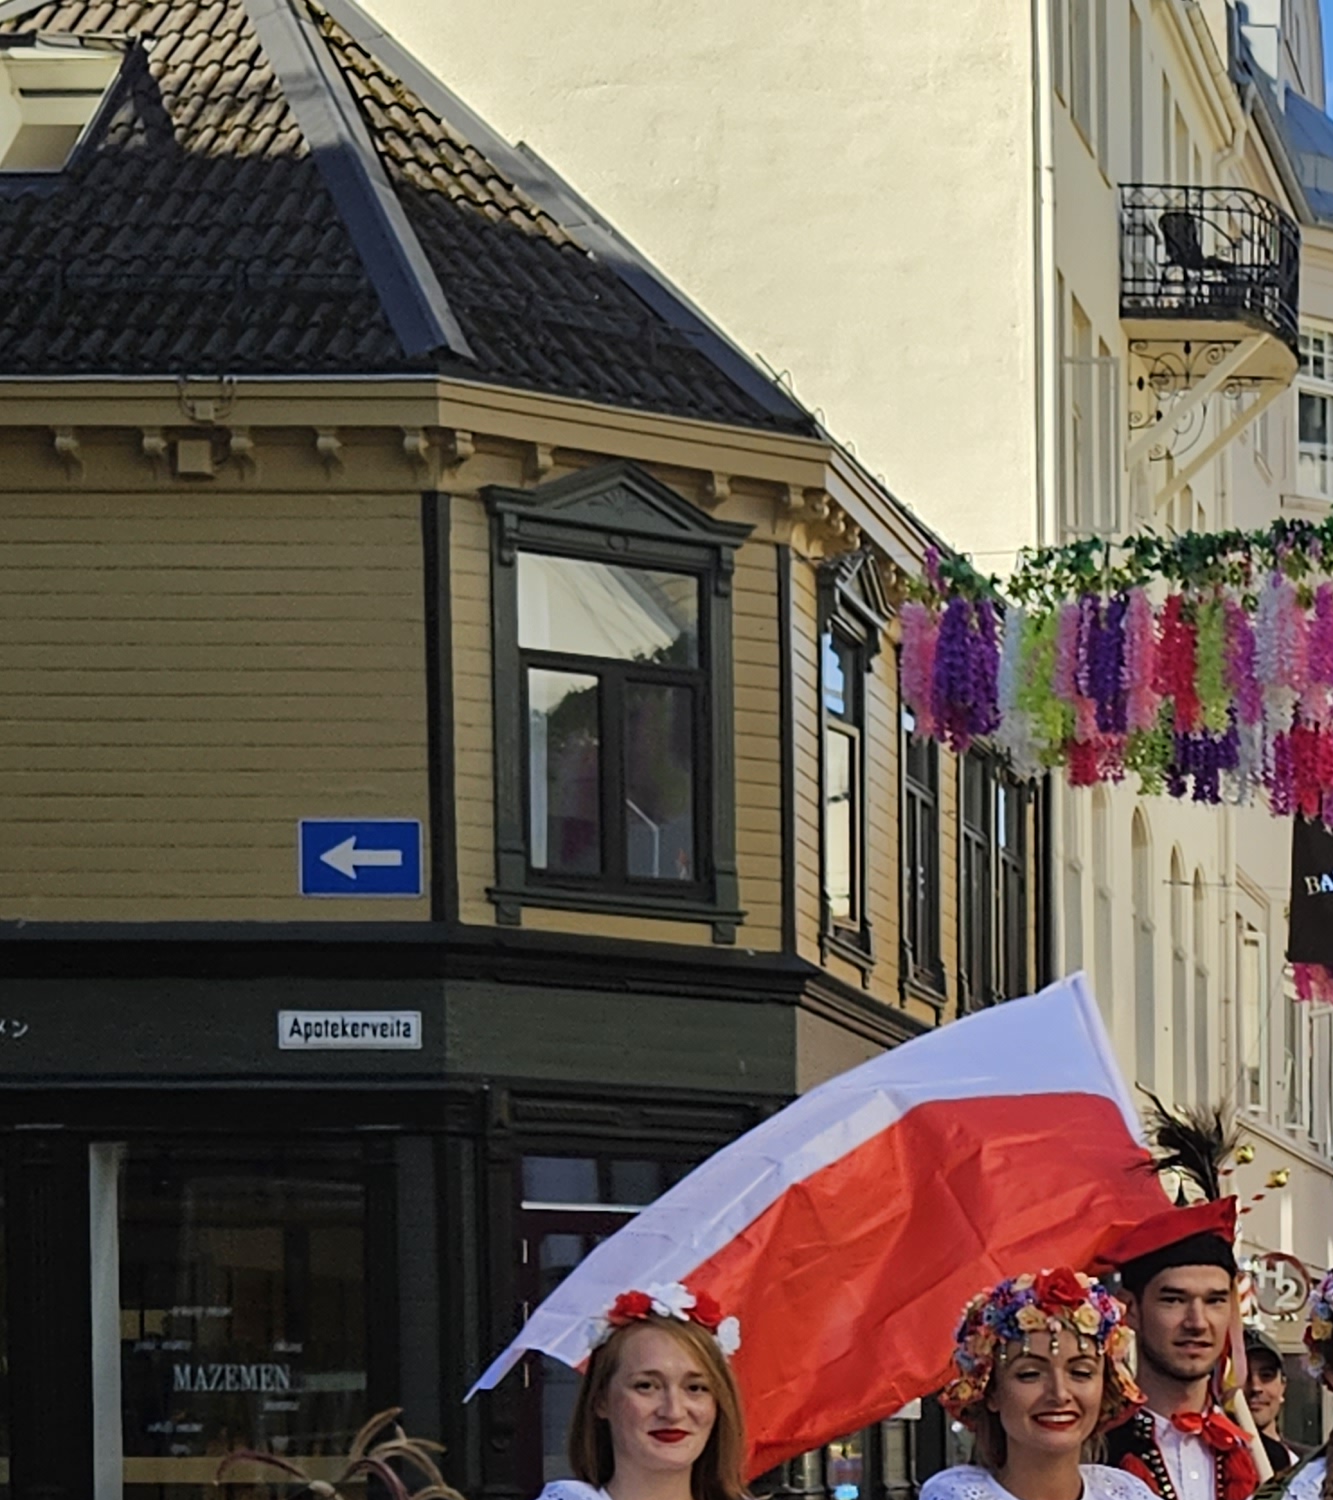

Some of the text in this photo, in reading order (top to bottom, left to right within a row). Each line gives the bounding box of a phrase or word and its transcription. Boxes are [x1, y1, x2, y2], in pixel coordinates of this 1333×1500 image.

[289, 1016, 412, 1043] Apotekerveita
[1258, 1260, 1298, 1309] H2
[173, 1363, 291, 1392] MAZEMEN
